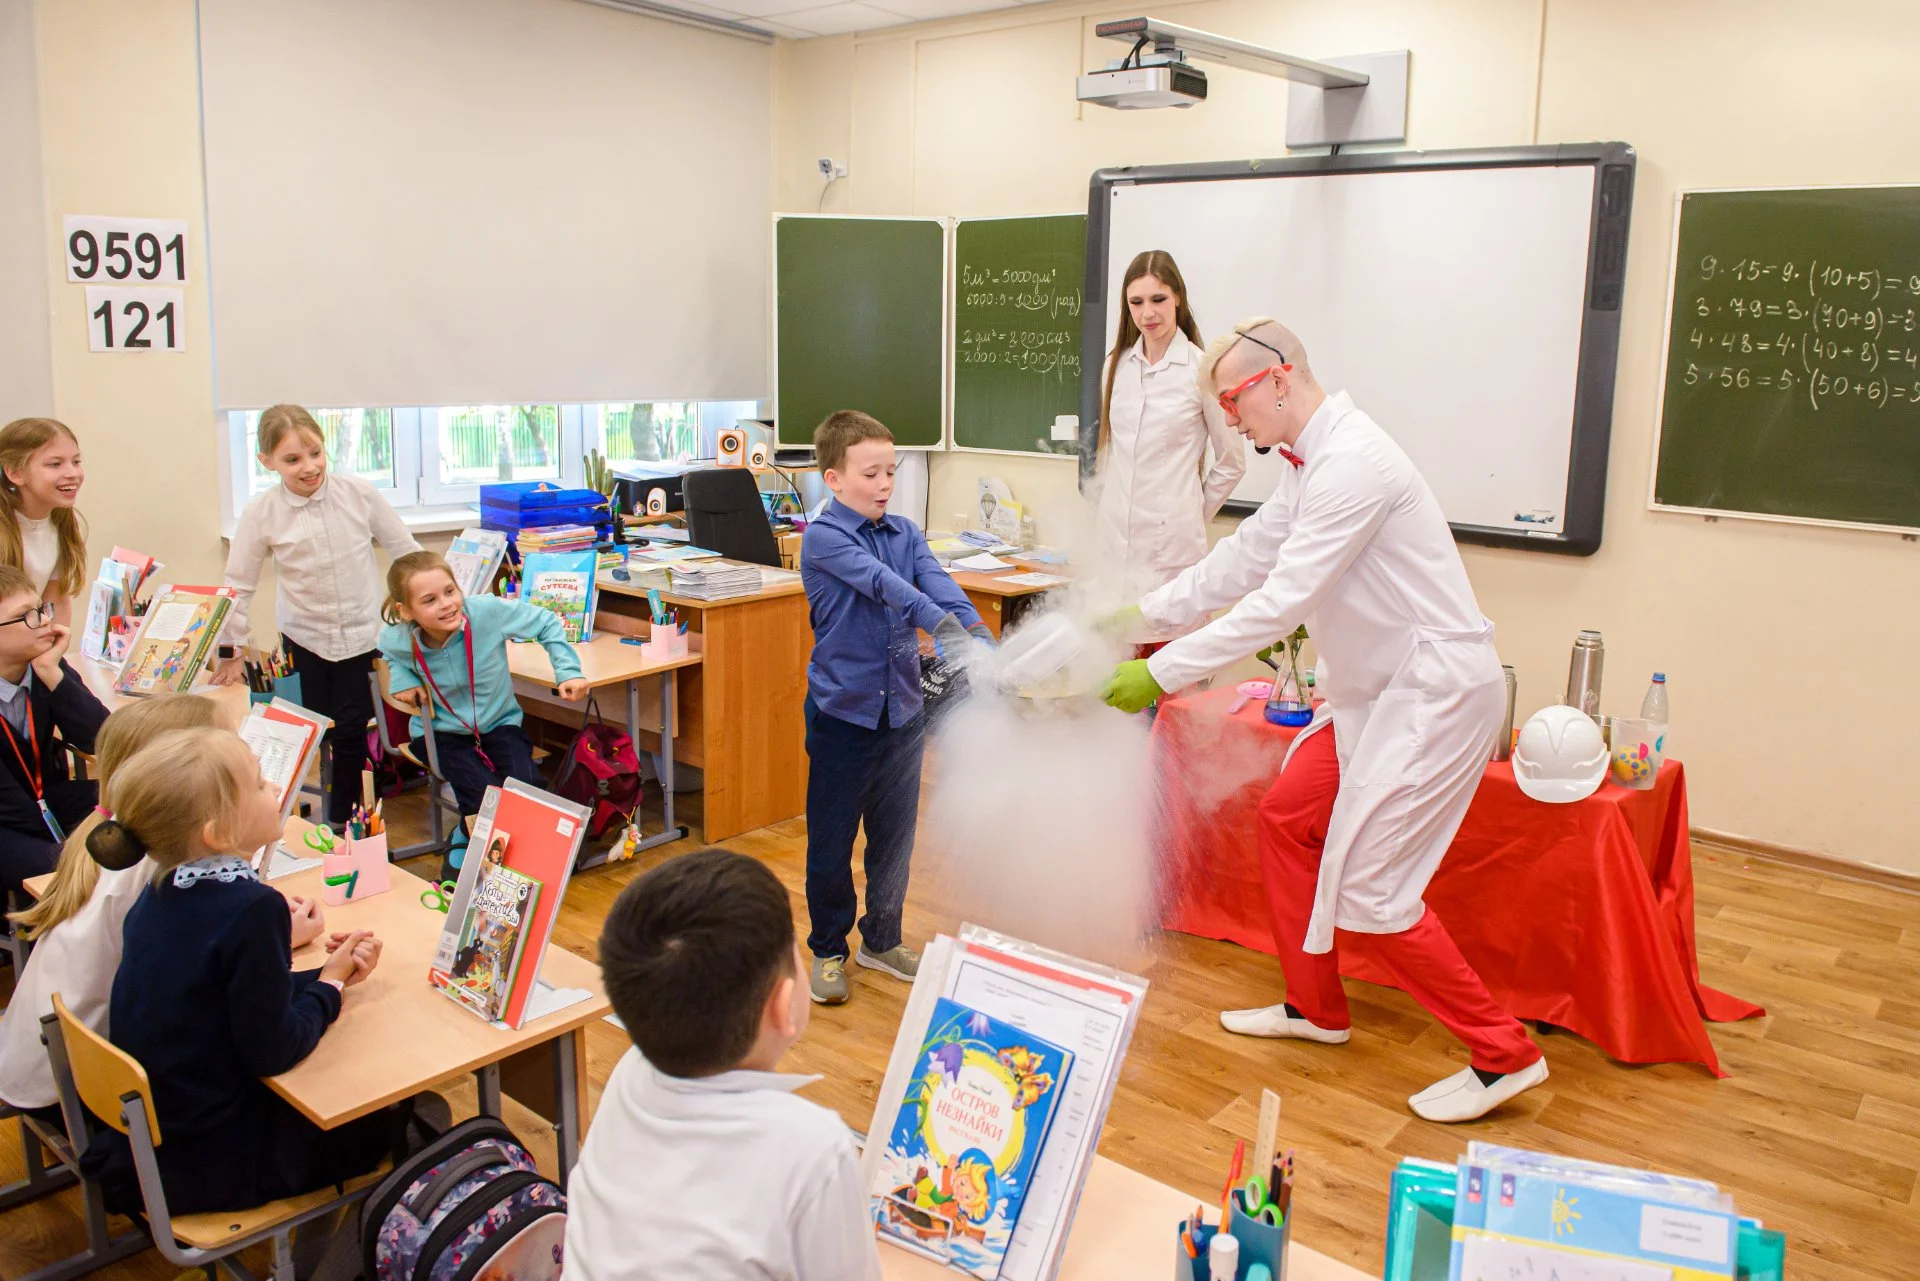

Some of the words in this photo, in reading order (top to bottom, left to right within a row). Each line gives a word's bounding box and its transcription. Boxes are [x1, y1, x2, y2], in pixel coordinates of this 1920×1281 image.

[69, 229, 186, 281] 9591
[93, 300, 176, 348] 121
[936, 1099, 1004, 1142] НЕЗНАЙКИ
[951, 1086, 1000, 1119] ОСТРОВ
